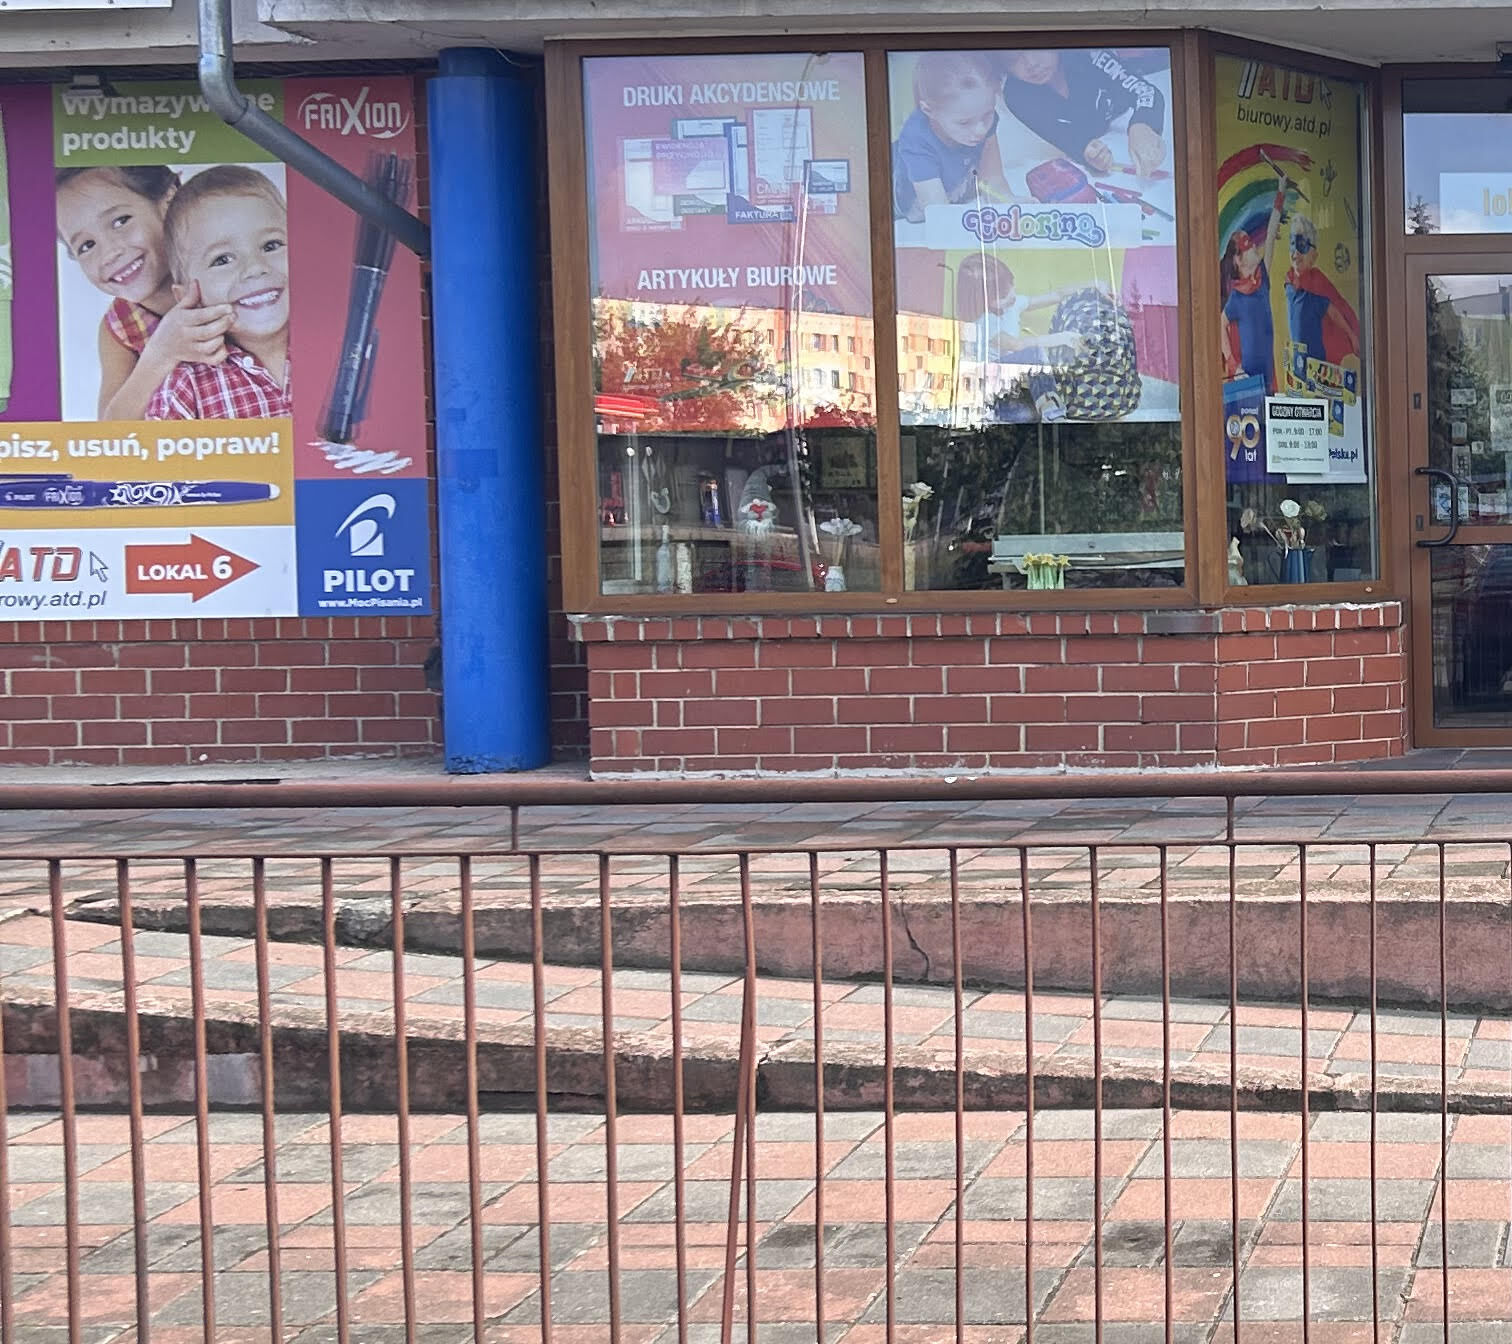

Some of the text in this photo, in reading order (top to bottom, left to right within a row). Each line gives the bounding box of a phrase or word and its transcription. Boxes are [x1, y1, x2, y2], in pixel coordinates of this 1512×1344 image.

[623, 80, 840, 106] DRUKI AKCYDENSOWE
[1237, 103, 1331, 138] biurowy.atd.pl
[62, 127, 196, 155] produkty
[962, 204, 1106, 248] Colorino
[637, 265, 837, 290] ARTYKUŁY BIUROWE
[68, 432, 148, 460] usuń,
[157, 432, 280, 461] popraw!
[1226, 414, 1261, 461] 90
[137, 555, 233, 580] LOKAL 6
[323, 569, 415, 592] PILOT
